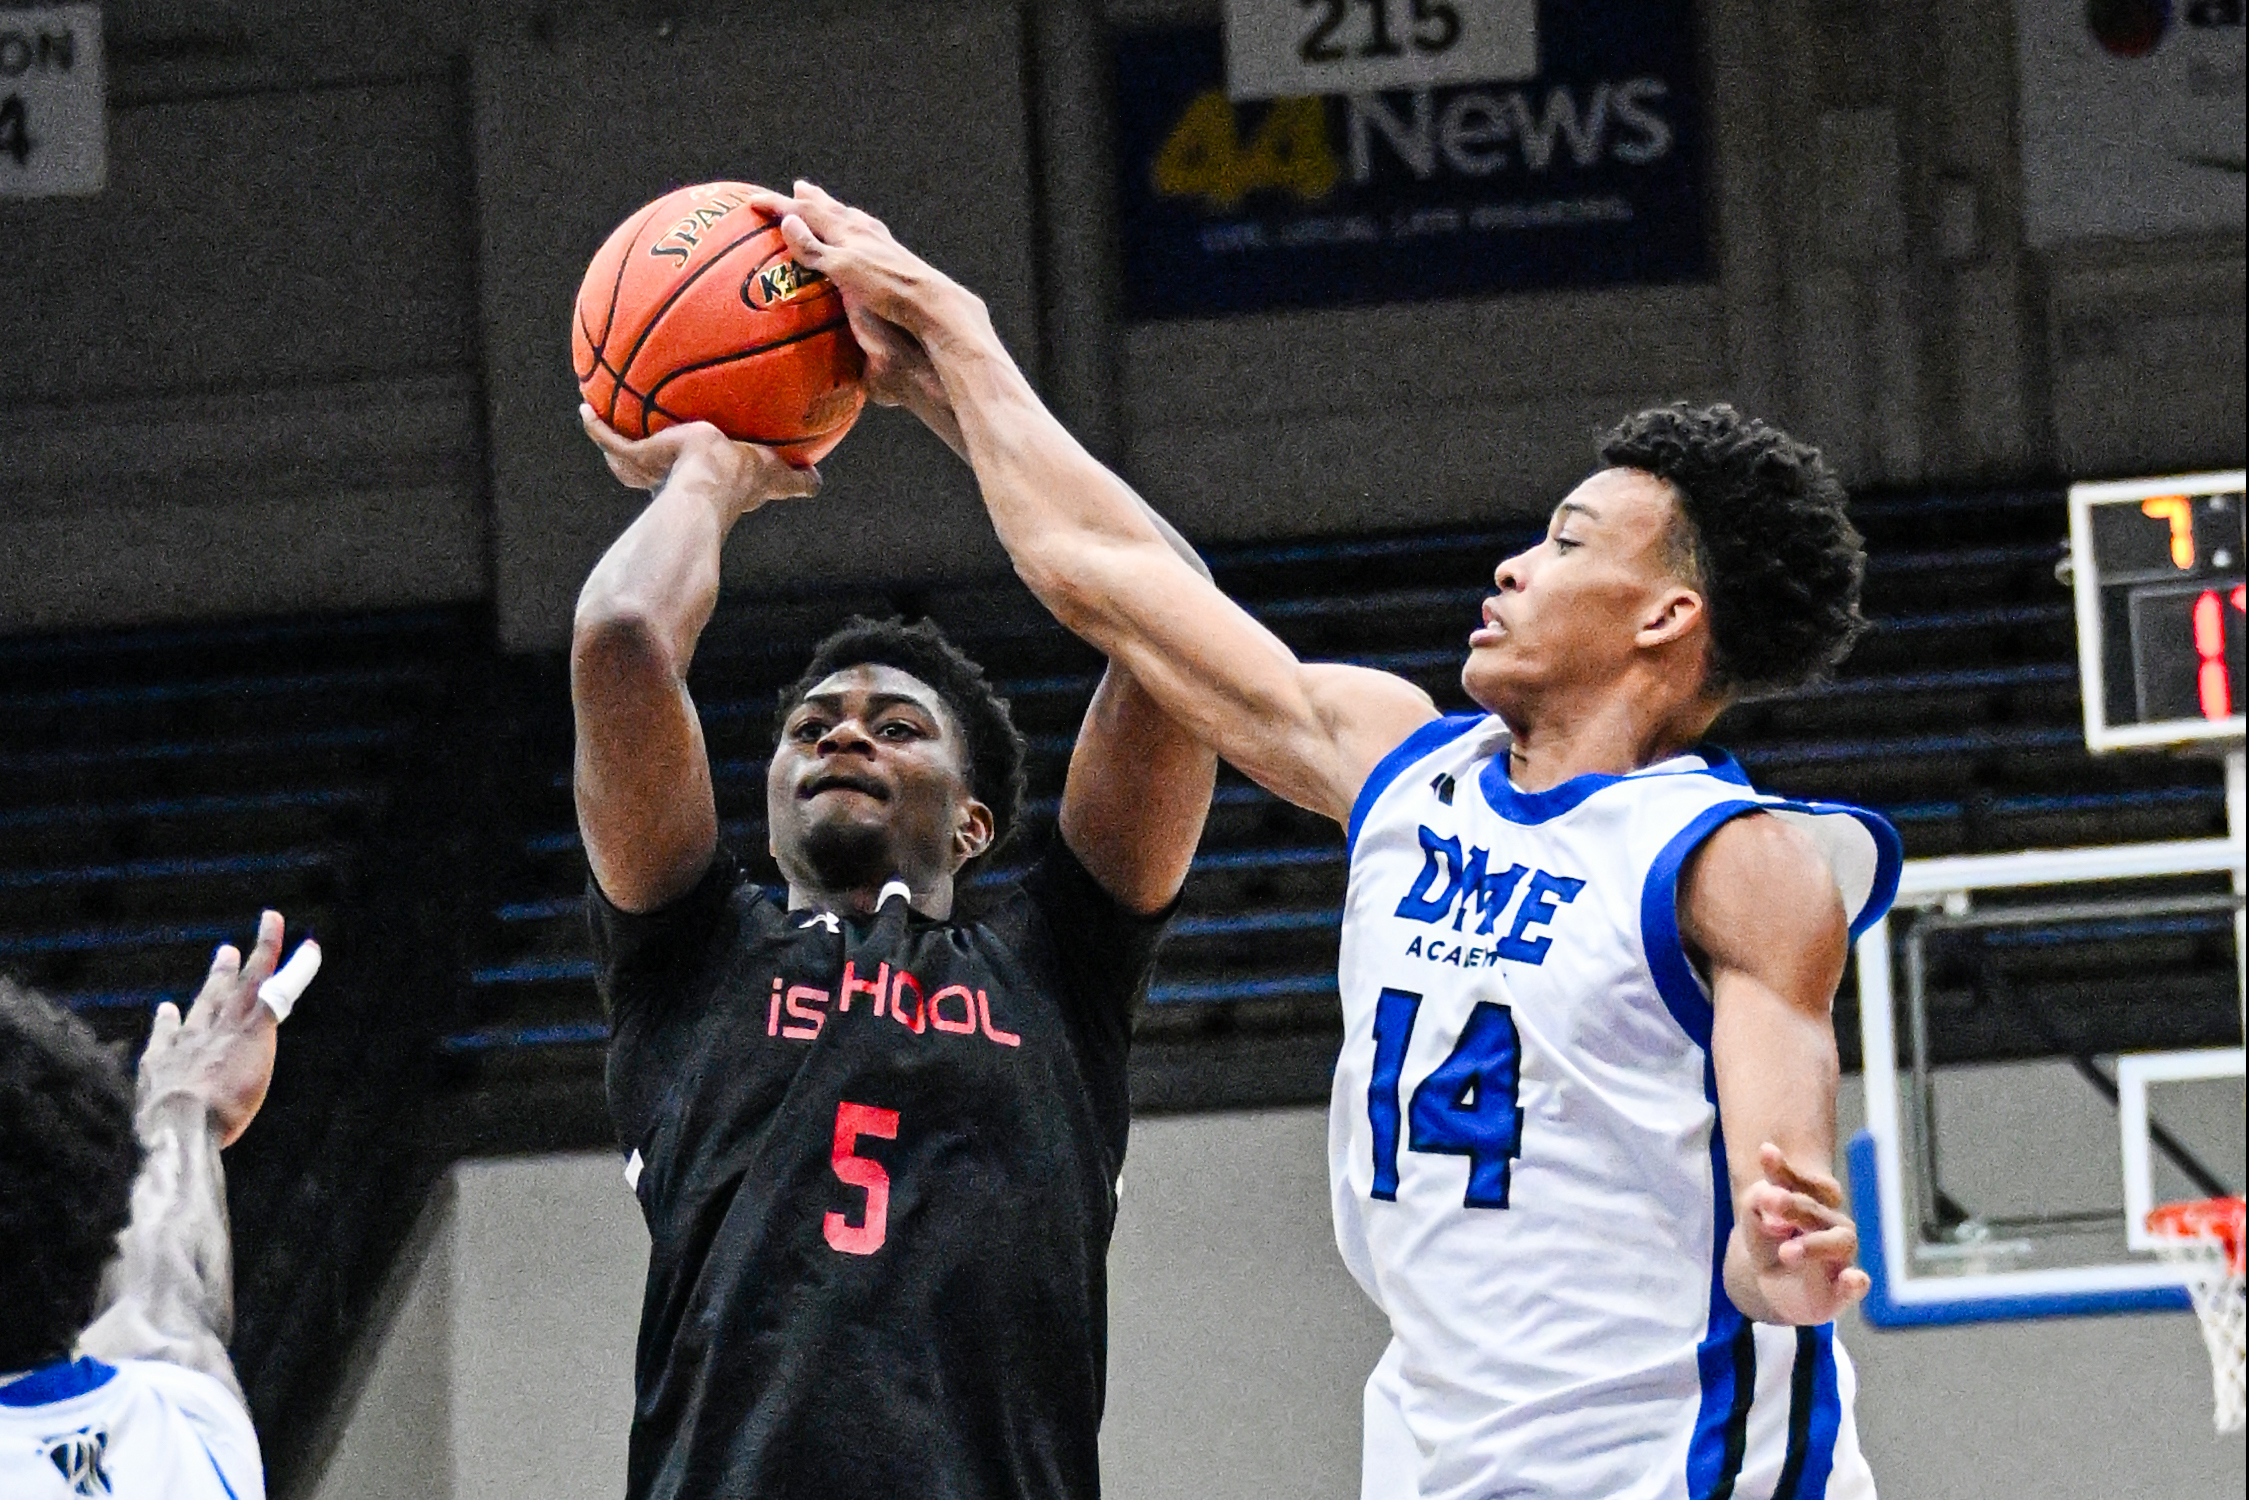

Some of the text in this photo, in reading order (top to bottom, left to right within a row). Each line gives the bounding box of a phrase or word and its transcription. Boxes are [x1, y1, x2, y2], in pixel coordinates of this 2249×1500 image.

[1302, 0, 1462, 64] 215
[1152, 76, 1674, 207] 44 News
[2141, 494, 2196, 570] 7
[2193, 583, 2246, 723] 1
[1393, 824, 1587, 967] DME
[1367, 986, 1525, 1210] 14
[822, 1100, 900, 1256] 5
